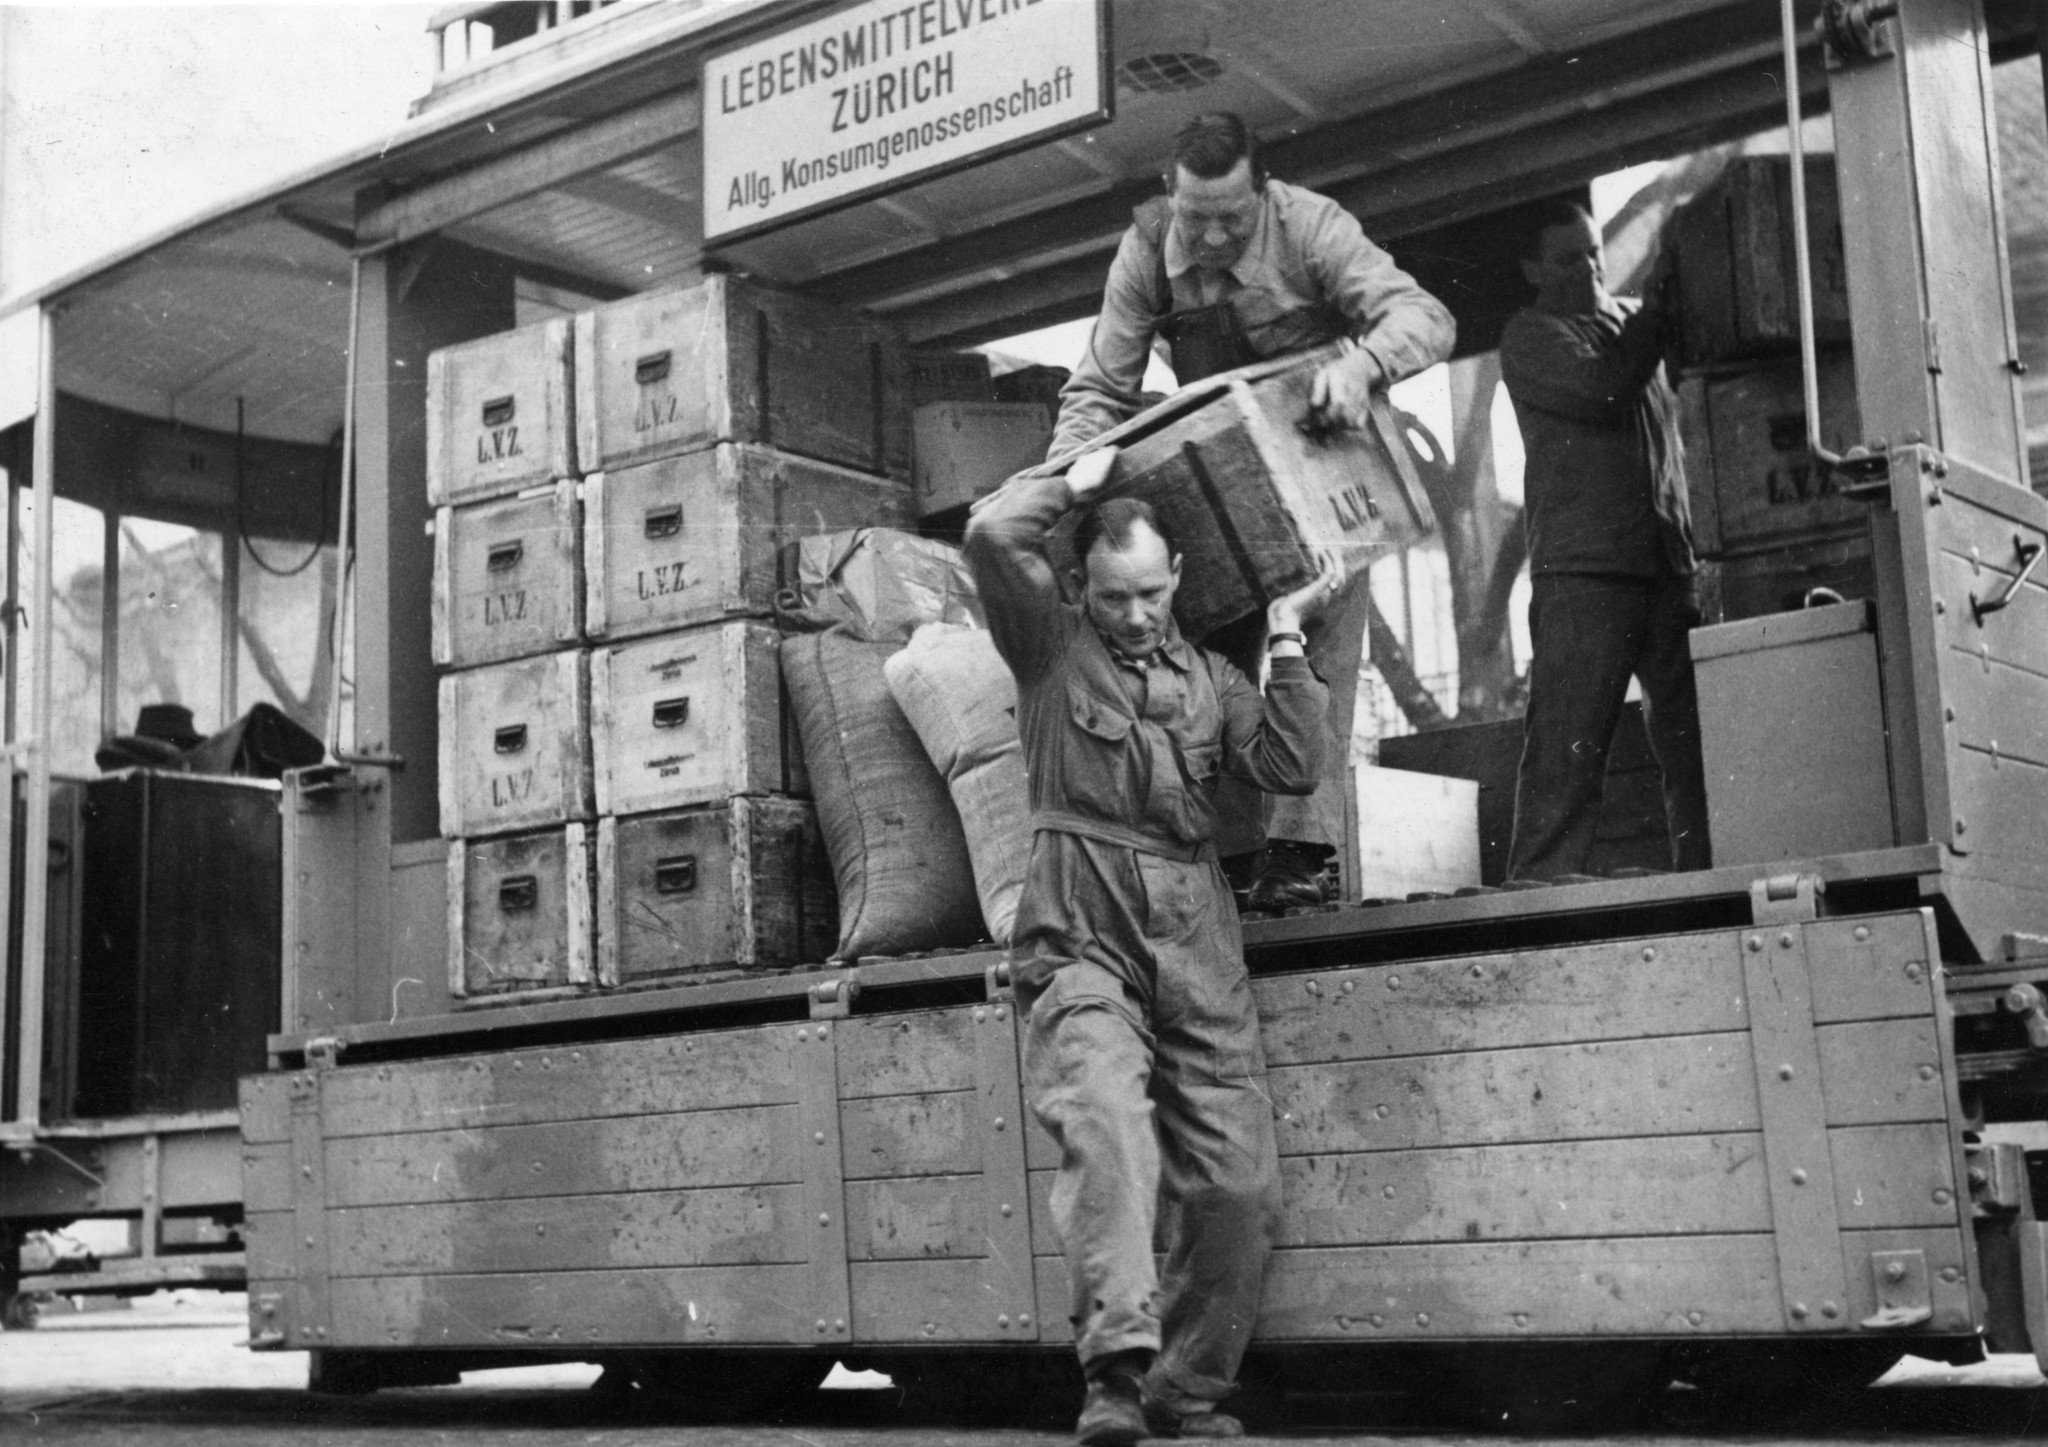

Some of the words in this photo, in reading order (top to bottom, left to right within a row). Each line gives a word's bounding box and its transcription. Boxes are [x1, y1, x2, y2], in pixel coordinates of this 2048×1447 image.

[721, 0, 1044, 115] LEBENSMITTELVE
[831, 51, 954, 133] ZÜRICH
[728, 171, 776, 210] Allg.
[782, 66, 1074, 194] Konsumgenossenschaft
